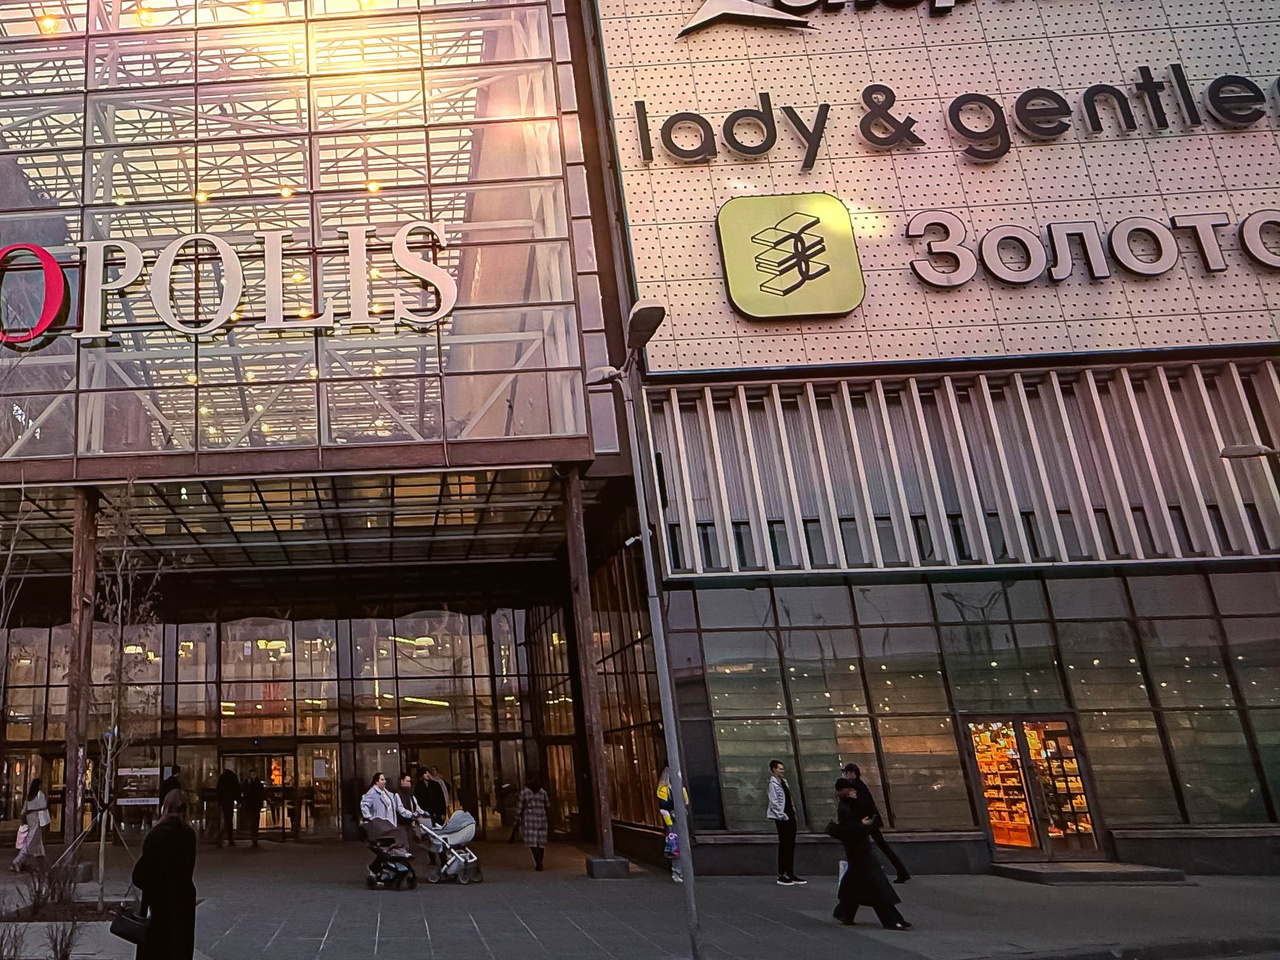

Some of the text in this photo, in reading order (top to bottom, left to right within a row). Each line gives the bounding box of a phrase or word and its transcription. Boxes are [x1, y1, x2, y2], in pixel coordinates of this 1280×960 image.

[634, 63, 1280, 174] lady & gentle
